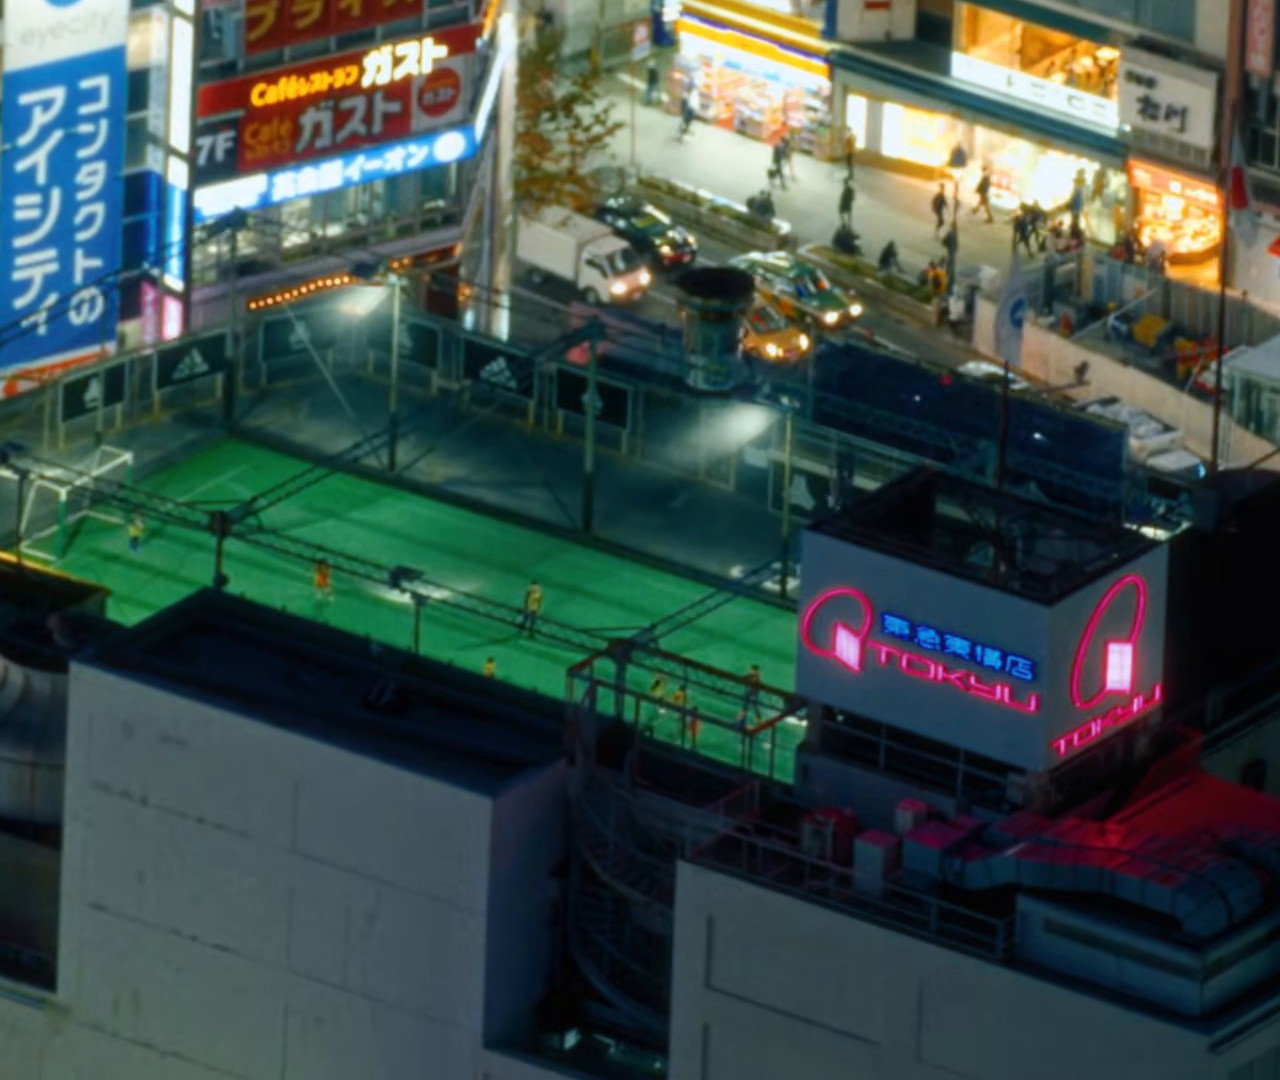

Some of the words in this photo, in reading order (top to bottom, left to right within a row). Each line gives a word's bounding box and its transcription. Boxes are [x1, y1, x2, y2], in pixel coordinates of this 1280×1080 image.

[361, 37, 449, 89] ガスト
[196, 130, 236, 167] 7F
[296, 88, 403, 154] ガスト
[12, 84, 67, 336] アイシティ
[67, 74, 111, 326] コンタクトの
[869, 639, 1040, 713] TOKYU
[881, 612, 1036, 682] 東急東横店
[1051, 682, 1163, 757] TOKYU
